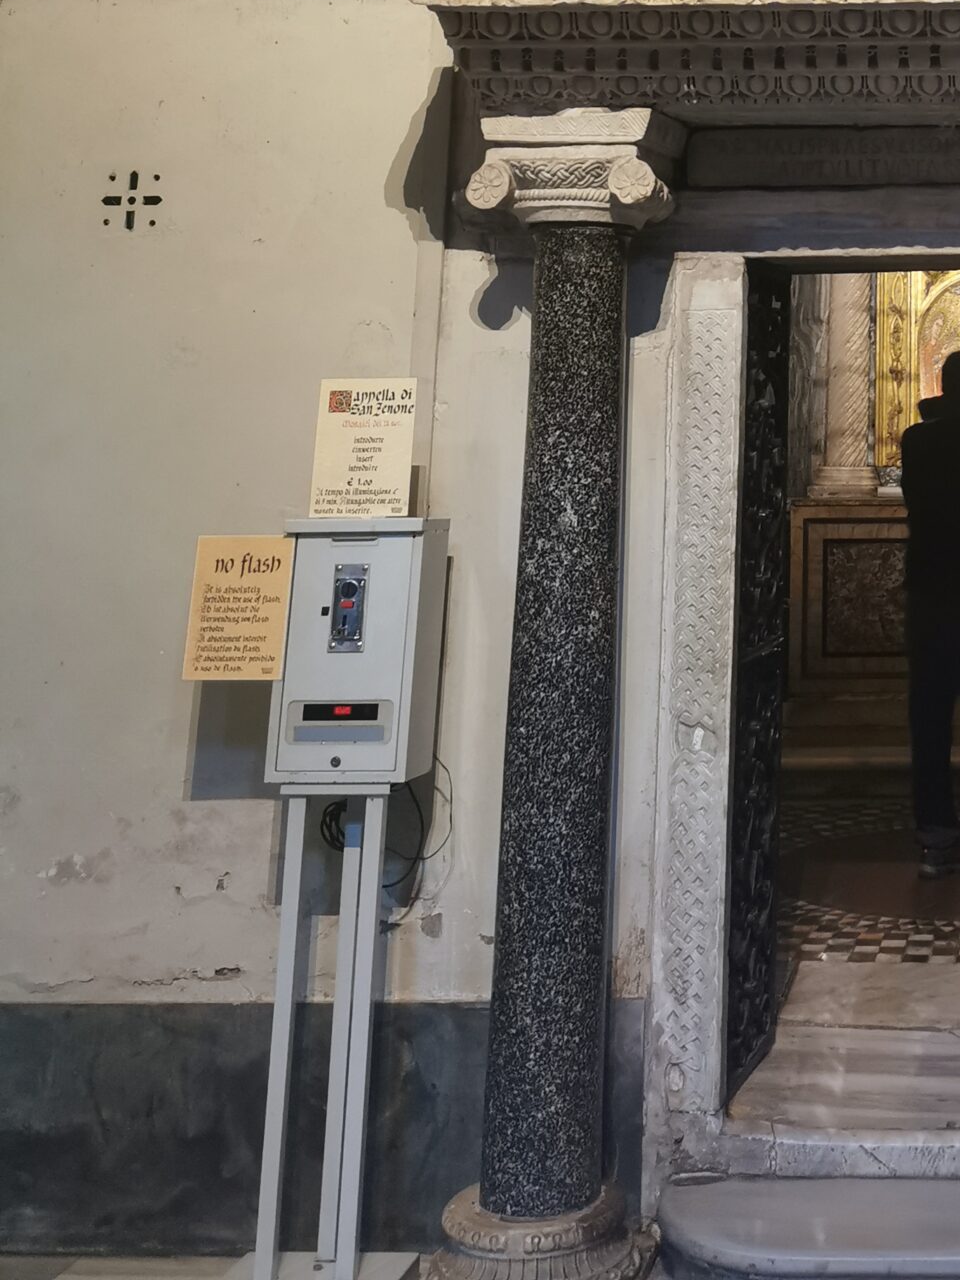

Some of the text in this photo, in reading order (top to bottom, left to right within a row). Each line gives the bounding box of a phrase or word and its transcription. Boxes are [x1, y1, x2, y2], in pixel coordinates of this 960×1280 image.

[400, 388, 413, 400] di
[350, 402, 415, 417] San Zenone
[214, 552, 282, 579] no flash
[215, 585, 222, 593] is
[223, 585, 261, 595] absolutely
